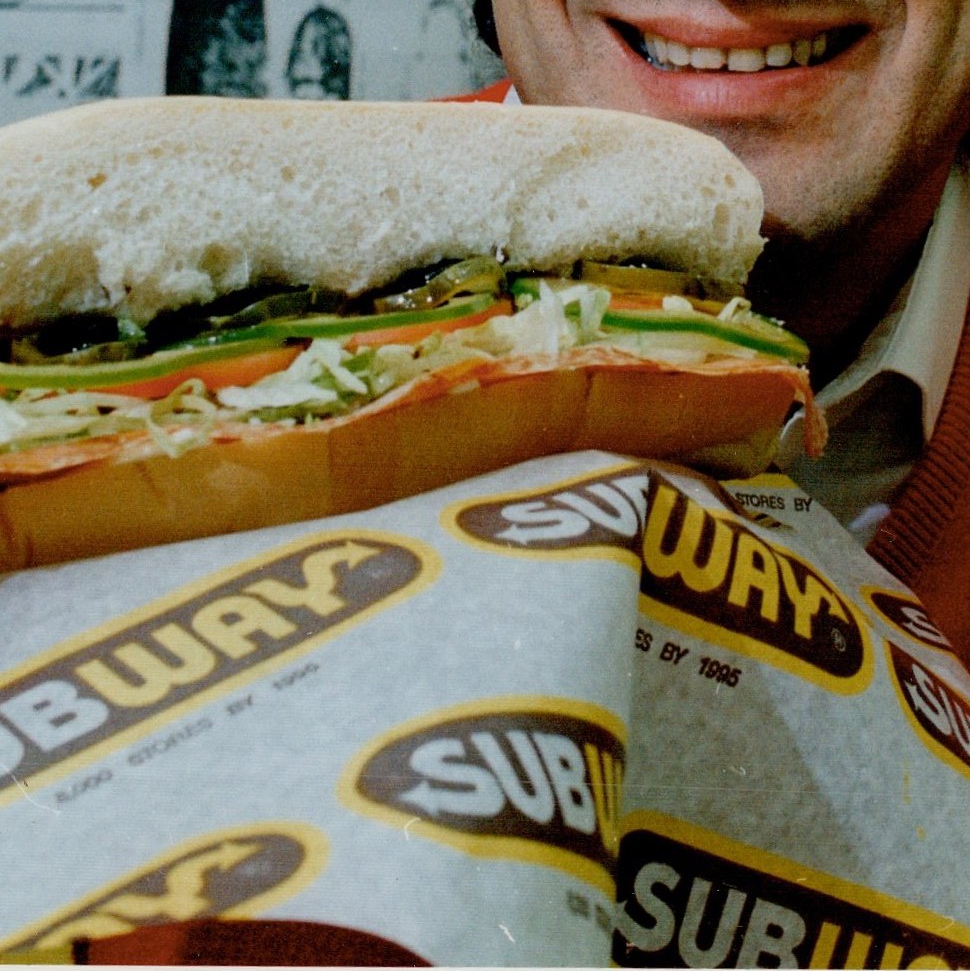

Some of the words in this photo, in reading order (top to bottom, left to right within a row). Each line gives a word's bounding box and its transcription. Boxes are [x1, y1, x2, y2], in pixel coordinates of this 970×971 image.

[735, 492, 786, 511] STORES
[793, 497, 813, 513] BY
[659, 641, 690, 666] BY
[699, 656, 743, 688] 1995
